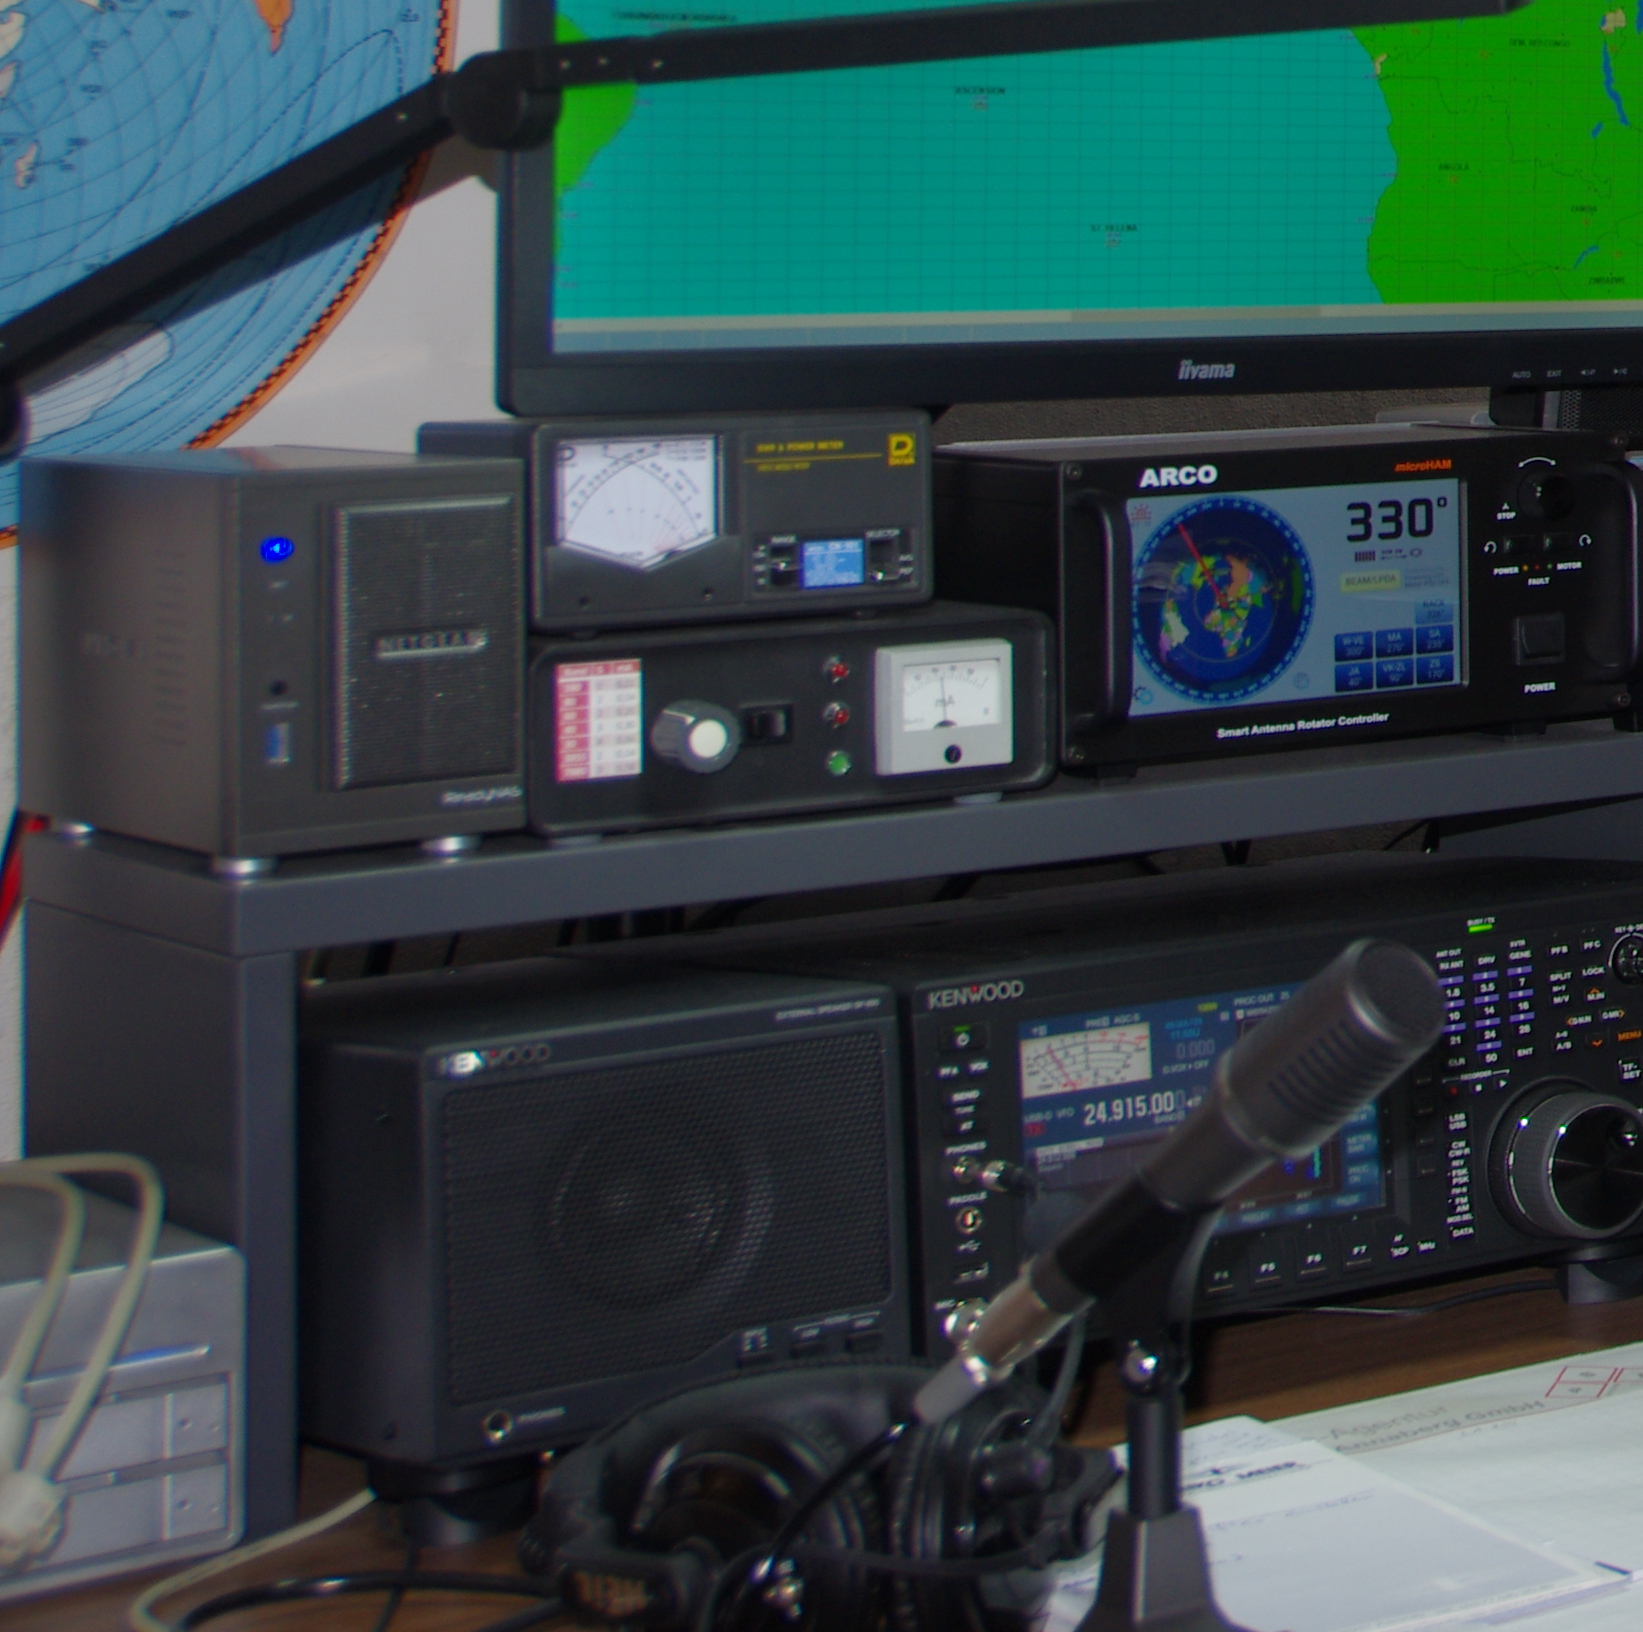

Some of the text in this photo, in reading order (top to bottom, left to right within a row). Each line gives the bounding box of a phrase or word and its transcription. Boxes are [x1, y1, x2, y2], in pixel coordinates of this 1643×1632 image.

[1178, 359, 1235, 381] iiyama
[1139, 465, 1218, 488] ARCO
[1395, 459, 1452, 472] microHAM
[1497, 512, 1516, 520] STOP
[1525, 683, 1556, 693] POWER
[1217, 712, 1390, 739] Smart Antenna Rotator Controller
[928, 980, 1024, 1010] KENWOOD
